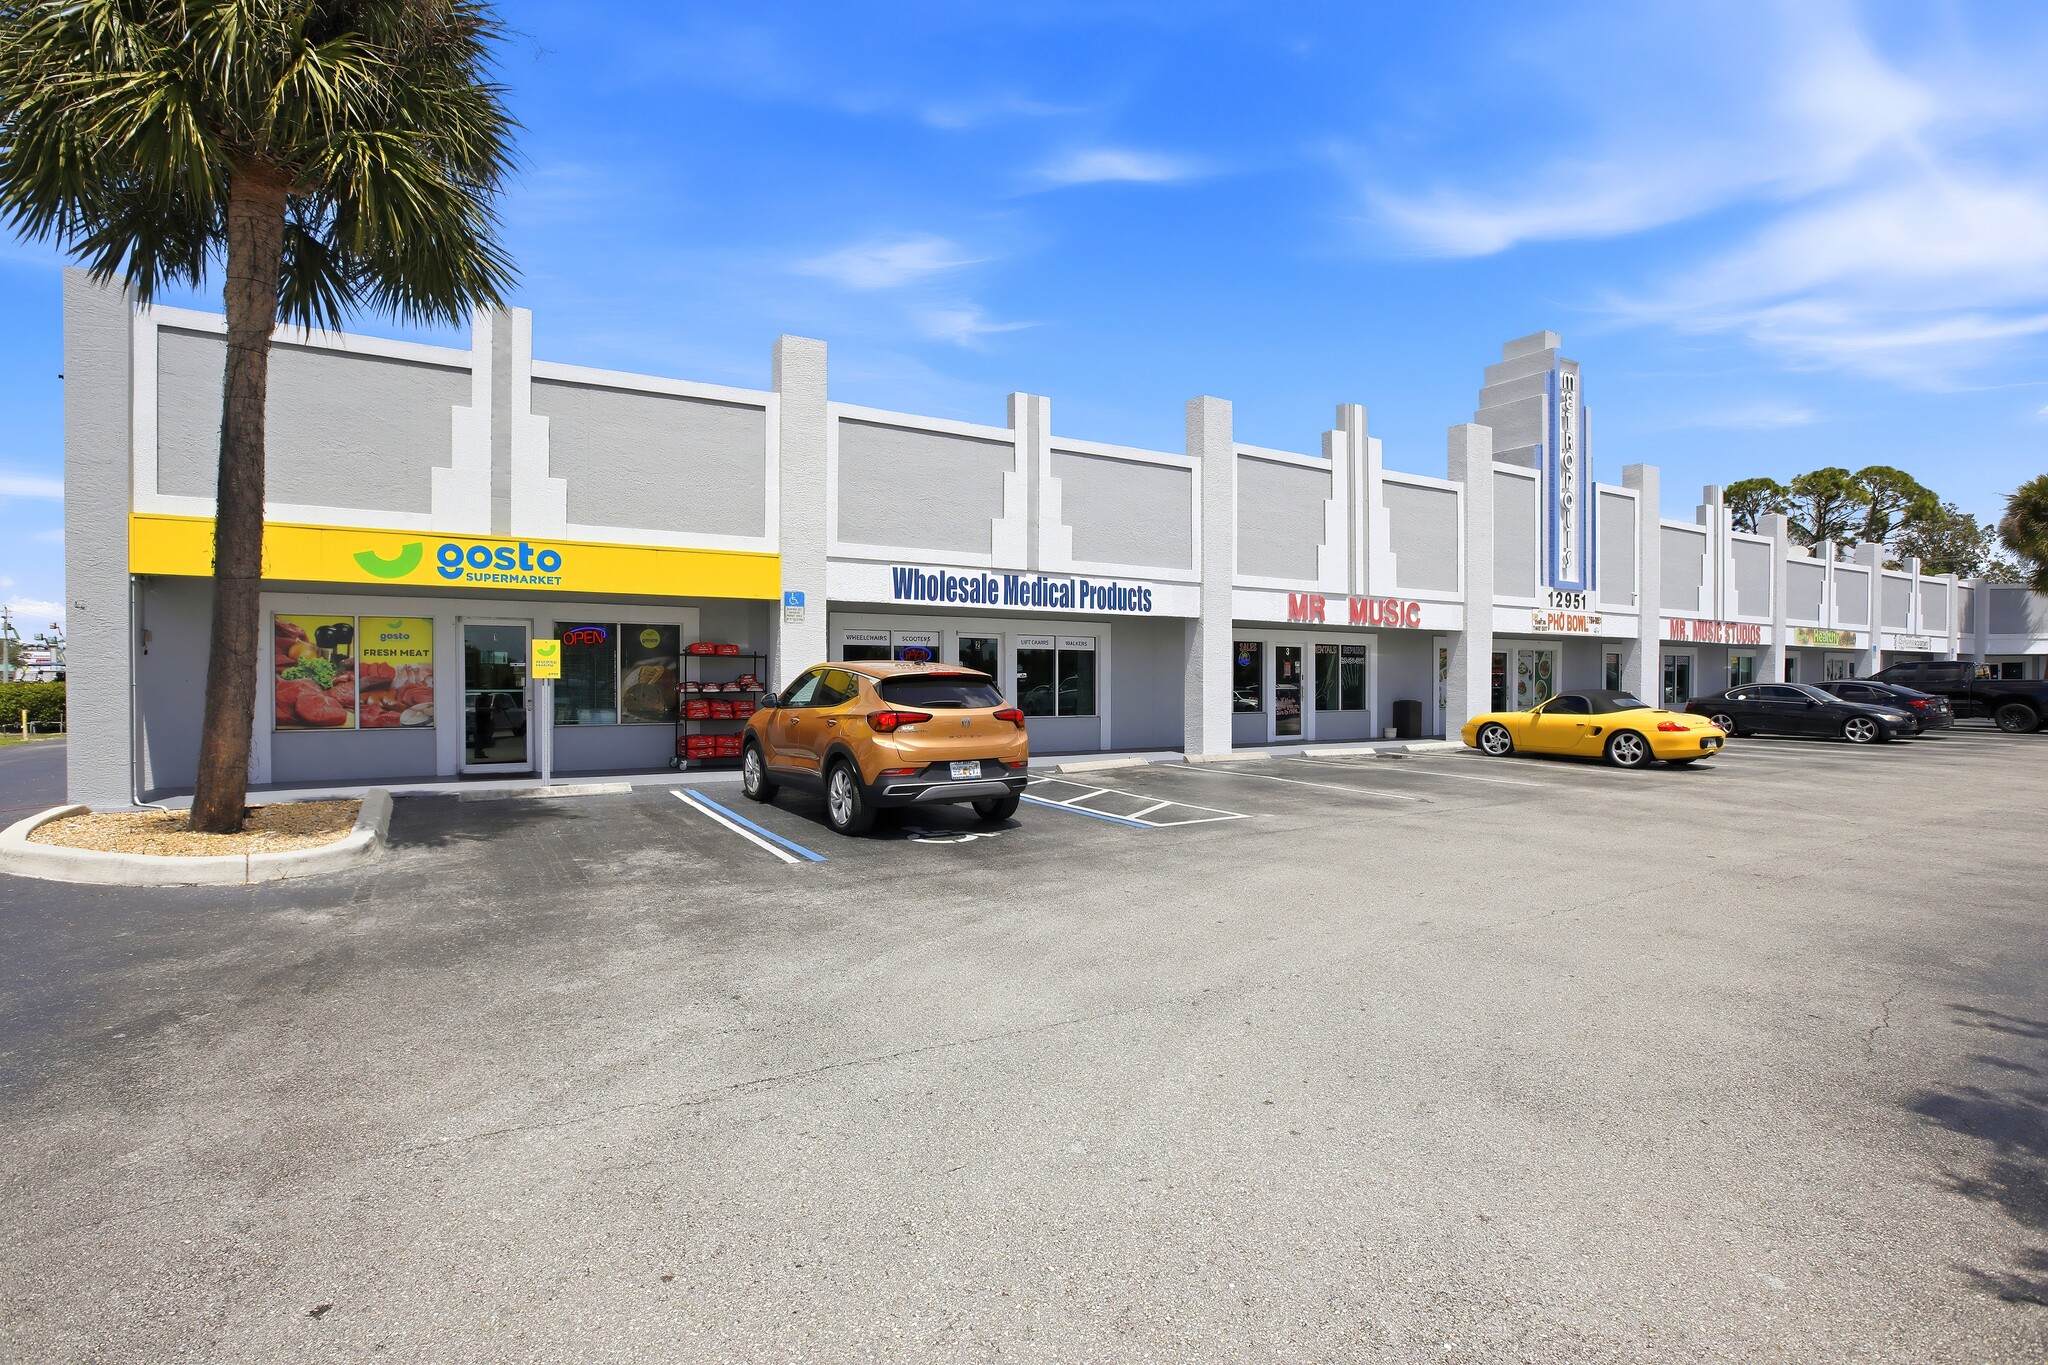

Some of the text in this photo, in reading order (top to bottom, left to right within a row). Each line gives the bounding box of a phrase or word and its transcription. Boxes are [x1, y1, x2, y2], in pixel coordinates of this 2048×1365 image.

[1563, 371, 1575, 568] METROPOLIS
[437, 542, 562, 580] gosto
[466, 572, 562, 586] SUPERMARKET
[892, 567, 1152, 613] Wholesale Medical Products
[1548, 591, 1586, 610] 12951
[1287, 593, 1421, 628] MR MUSIC
[1567, 614, 1589, 632] BOWL
[1669, 618, 1761, 645] MR. MUSIC STUDIOS
[380, 632, 410, 642] gosto
[563, 630, 604, 645] OPEN
[1813, 628, 1840, 645] Healthy
[363, 649, 430, 657] FRESH MEAT
[1285, 647, 1290, 656] 3
[1315, 645, 1337, 654] ENTALS
